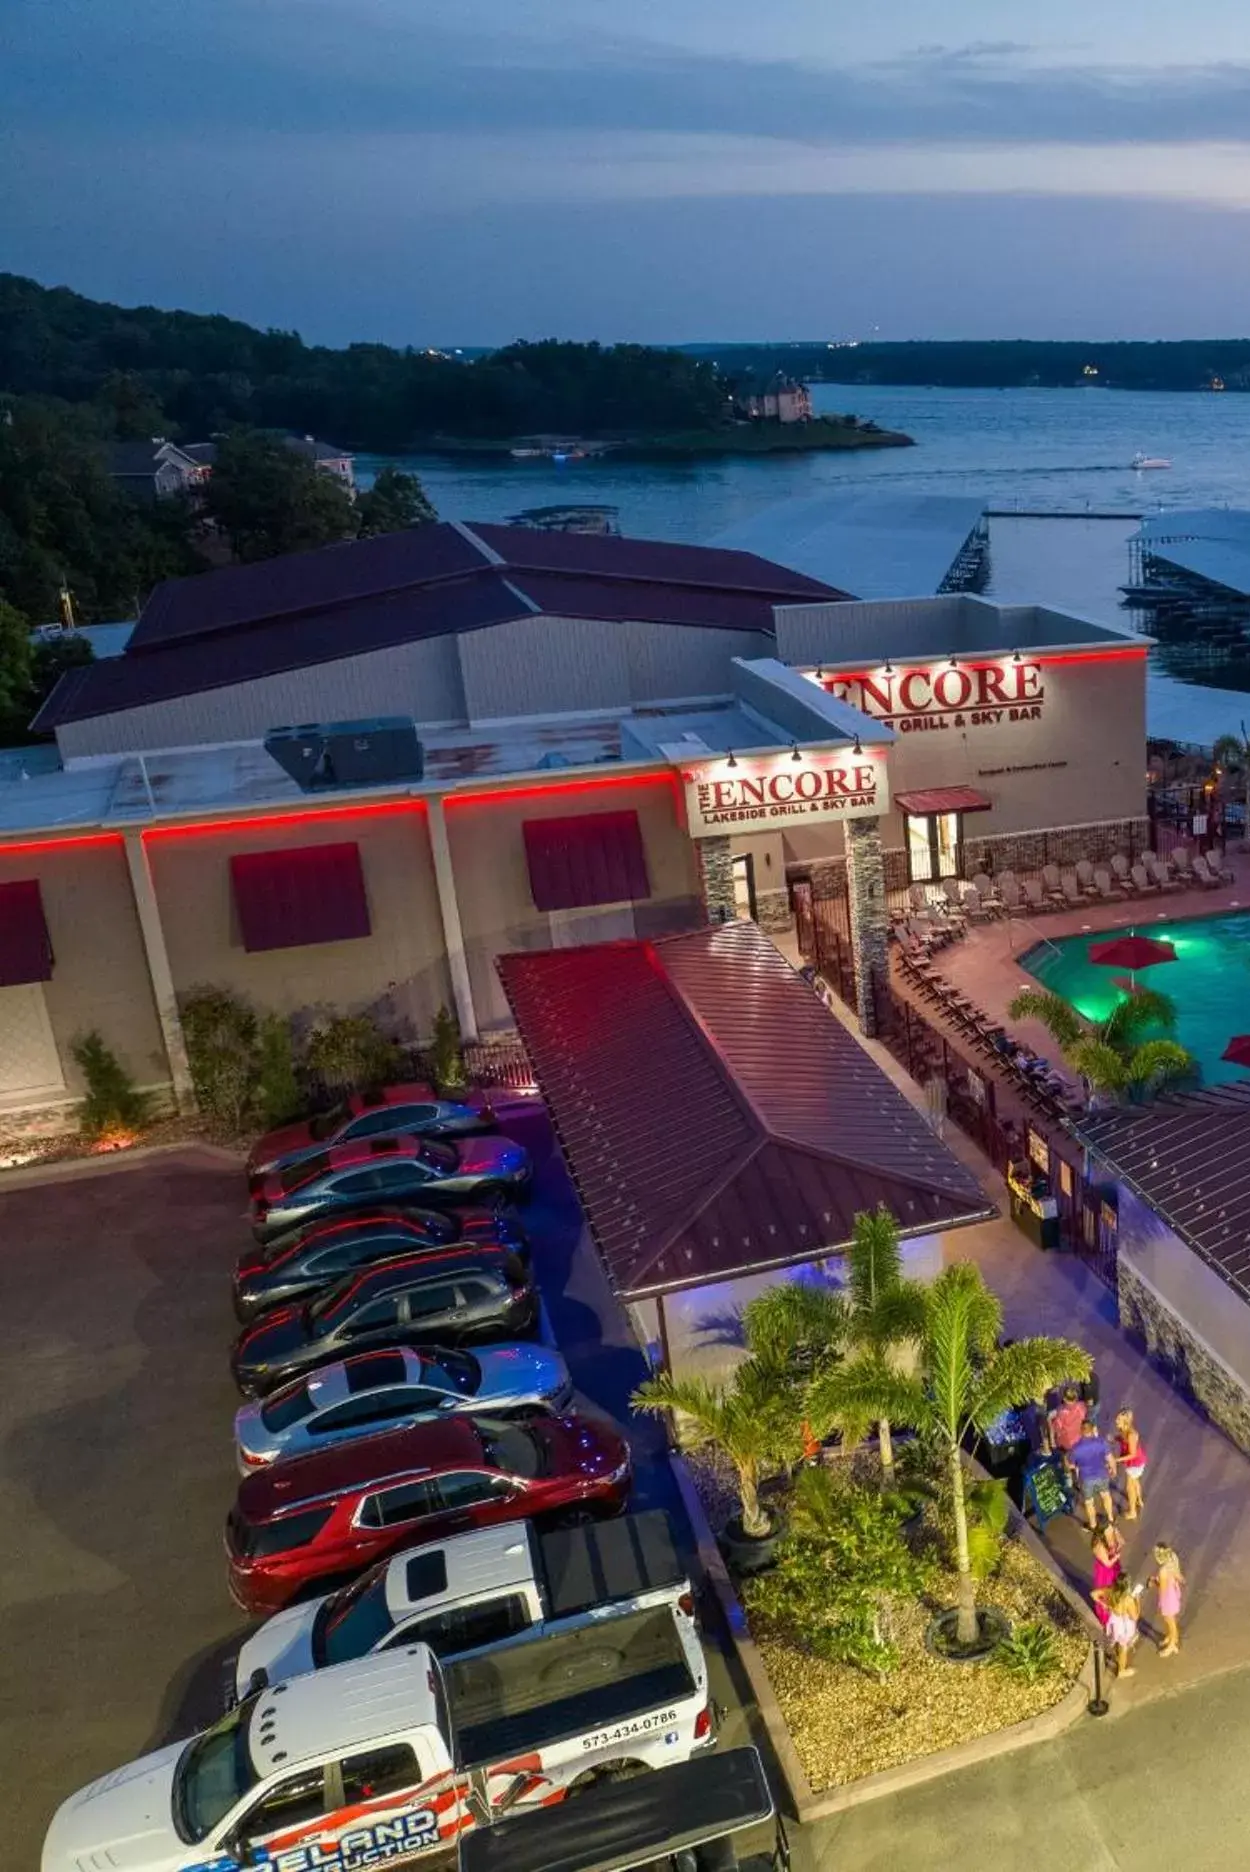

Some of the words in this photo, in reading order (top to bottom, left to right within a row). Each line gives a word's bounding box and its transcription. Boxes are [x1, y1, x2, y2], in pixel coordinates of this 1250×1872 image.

[821, 663, 1044, 715] ENCORE
[900, 717, 948, 733] GRILL
[955, 713, 966, 727] &
[971, 709, 1003, 725] SKY
[1009, 706, 1042, 721] BAR
[698, 783, 709, 811] THE
[712, 765, 877, 810] ENCORE
[704, 808, 766, 825] LAKESIDE
[772, 805, 806, 818] GRILL
[811, 801, 820, 812] &
[823, 797, 847, 811] SKY
[851, 795, 876, 807] BAR
[582, 1709, 677, 1750] 573-434-0786
